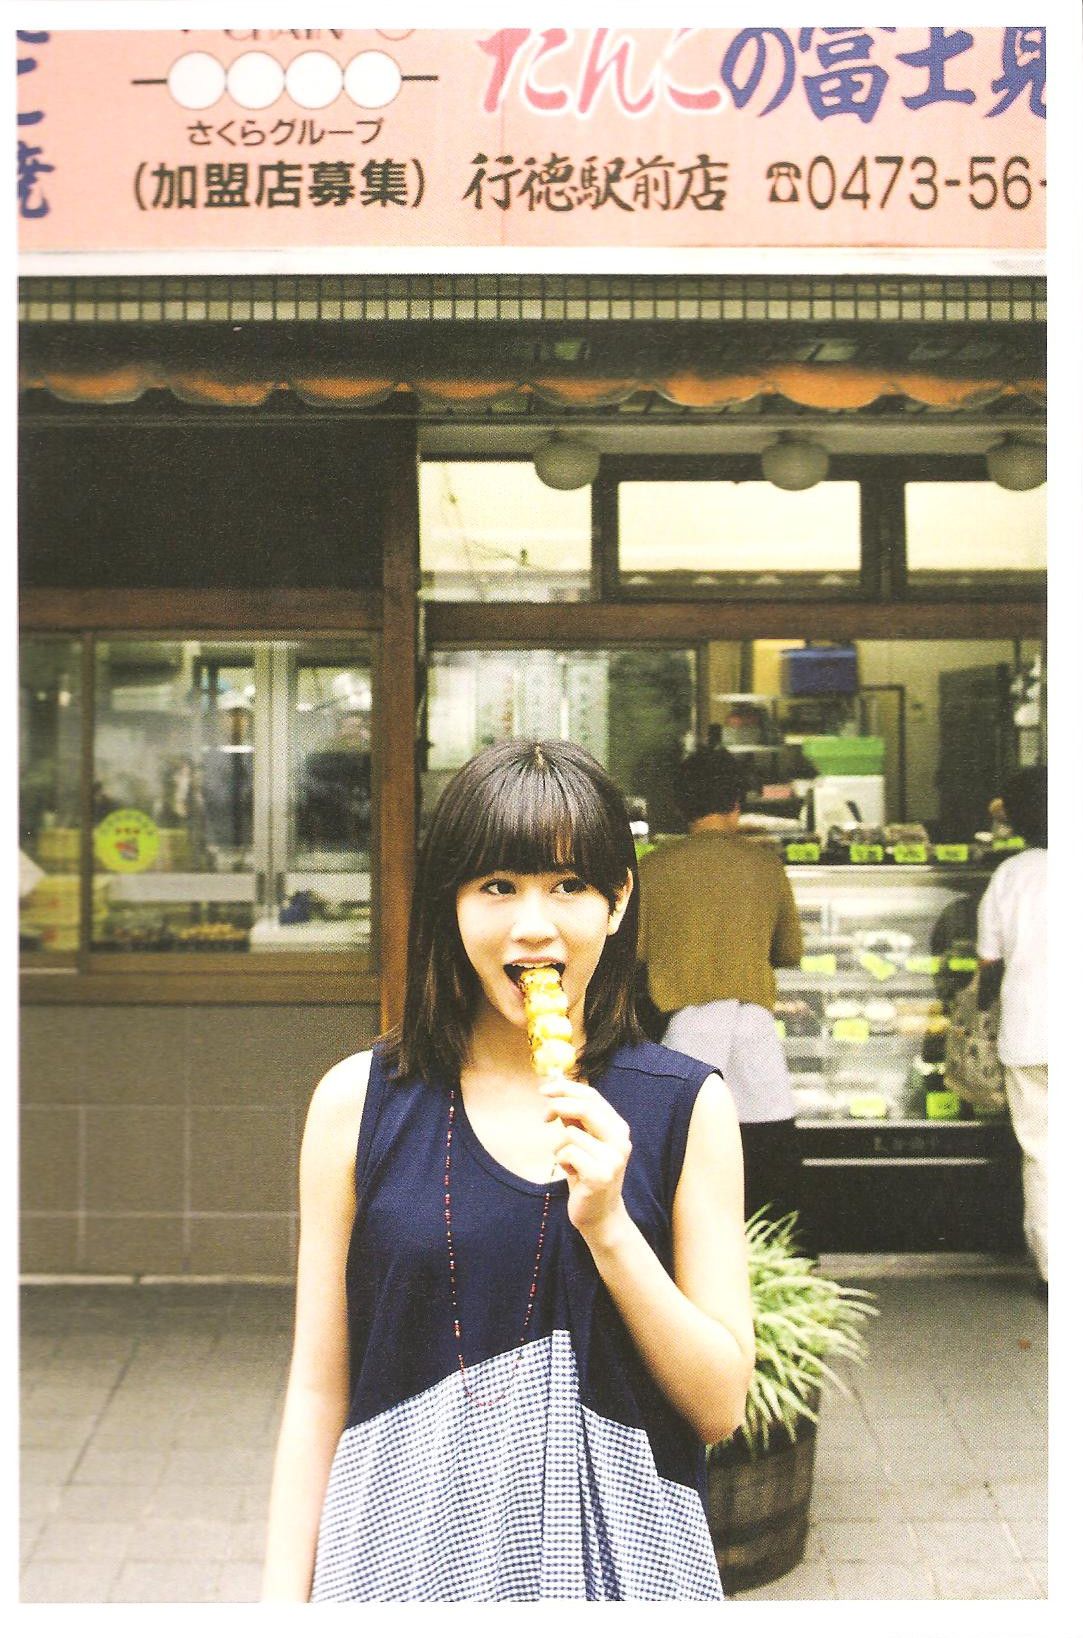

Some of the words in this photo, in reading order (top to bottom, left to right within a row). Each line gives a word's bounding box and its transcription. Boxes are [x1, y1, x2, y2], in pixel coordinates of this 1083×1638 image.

[186, 117, 385, 146] さくらグループ
[134, 158, 425, 211] (加盟店募集)
[461, 152, 729, 212] 行徳駅前店
